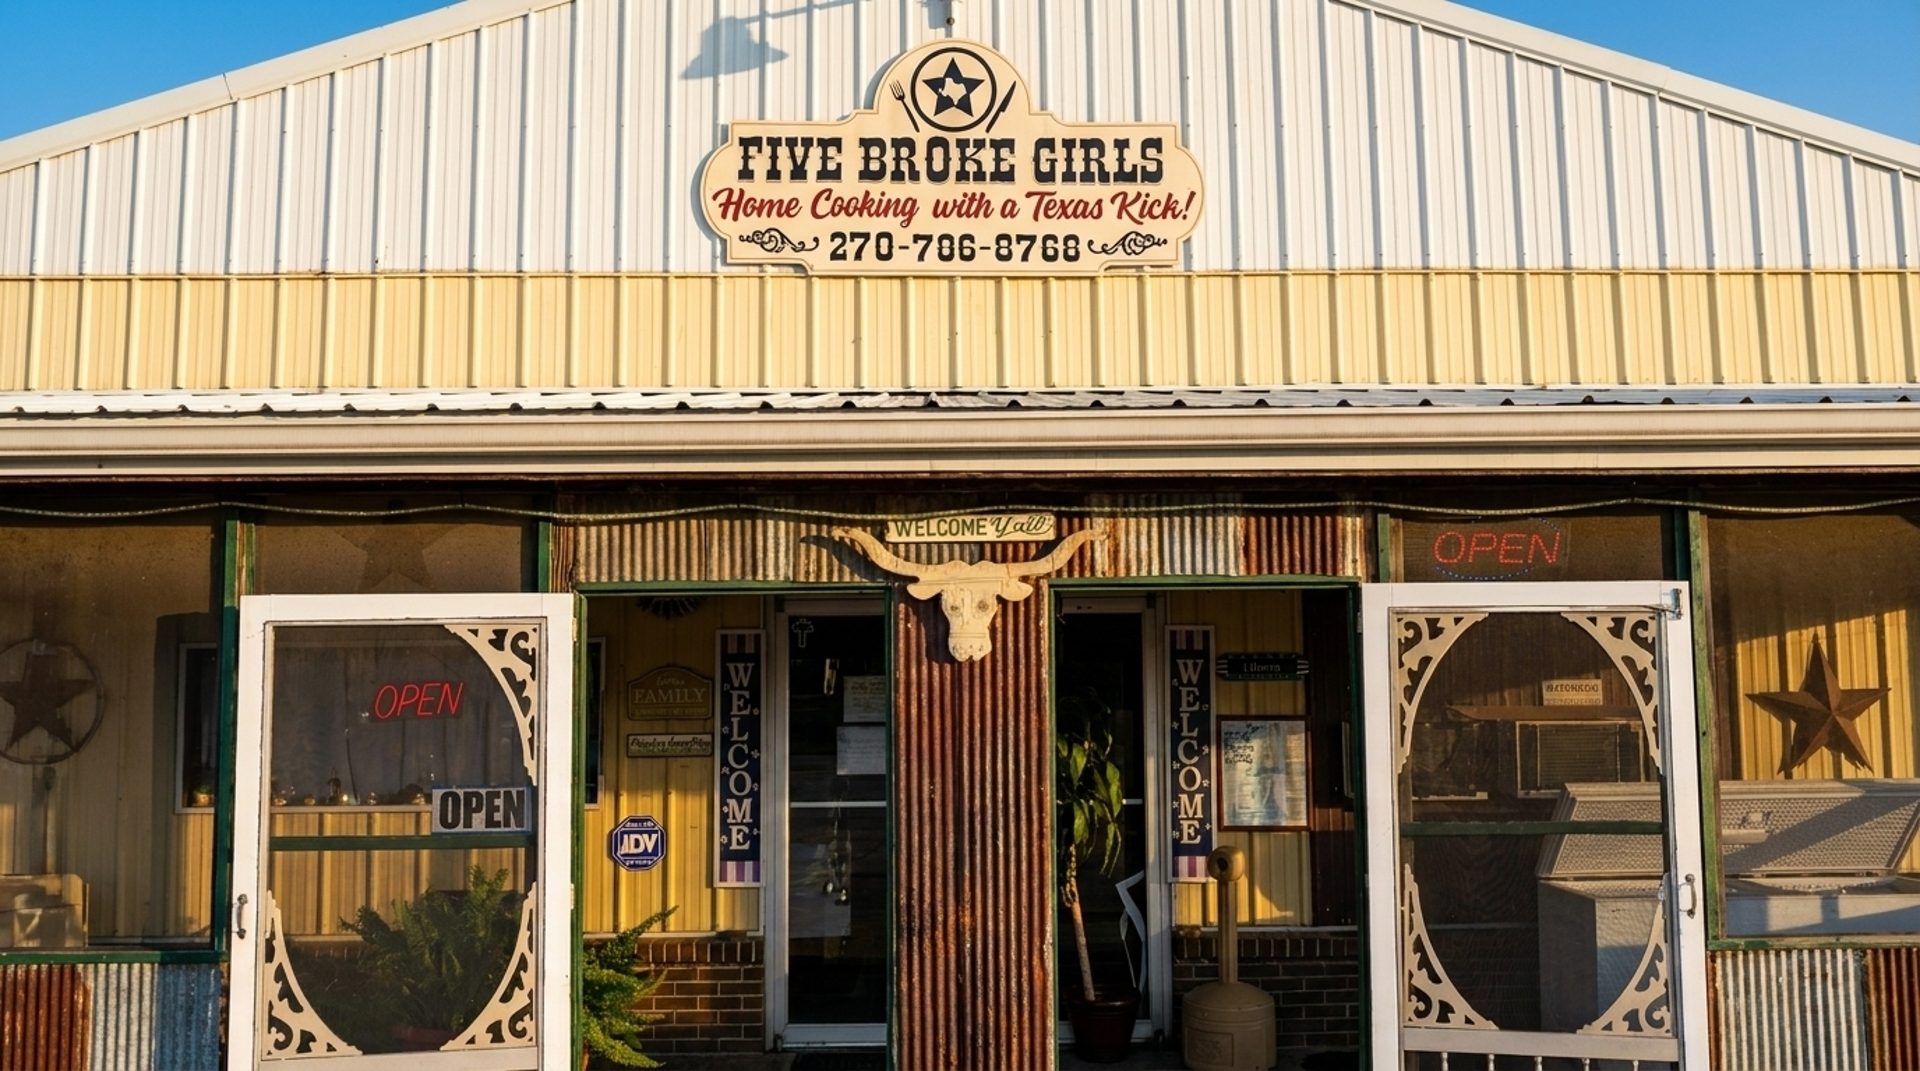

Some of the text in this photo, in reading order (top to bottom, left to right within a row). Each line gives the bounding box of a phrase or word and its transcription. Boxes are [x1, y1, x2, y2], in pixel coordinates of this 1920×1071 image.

[738, 136, 1163, 184] FIVE BROKE GIRLS
[712, 187, 1196, 228] Home Cooking with a Texas Kick!
[829, 232, 1080, 262] 270-786-8768
[894, 517, 987, 537] WELCOME
[1433, 530, 1561, 565] OPEN
[374, 681, 464, 721] OPEN
[633, 688, 707, 704] FAMILY
[726, 662, 756, 850] WELCOME
[1176, 659, 1205, 845] WELCOME
[438, 790, 525, 830] OPEN
